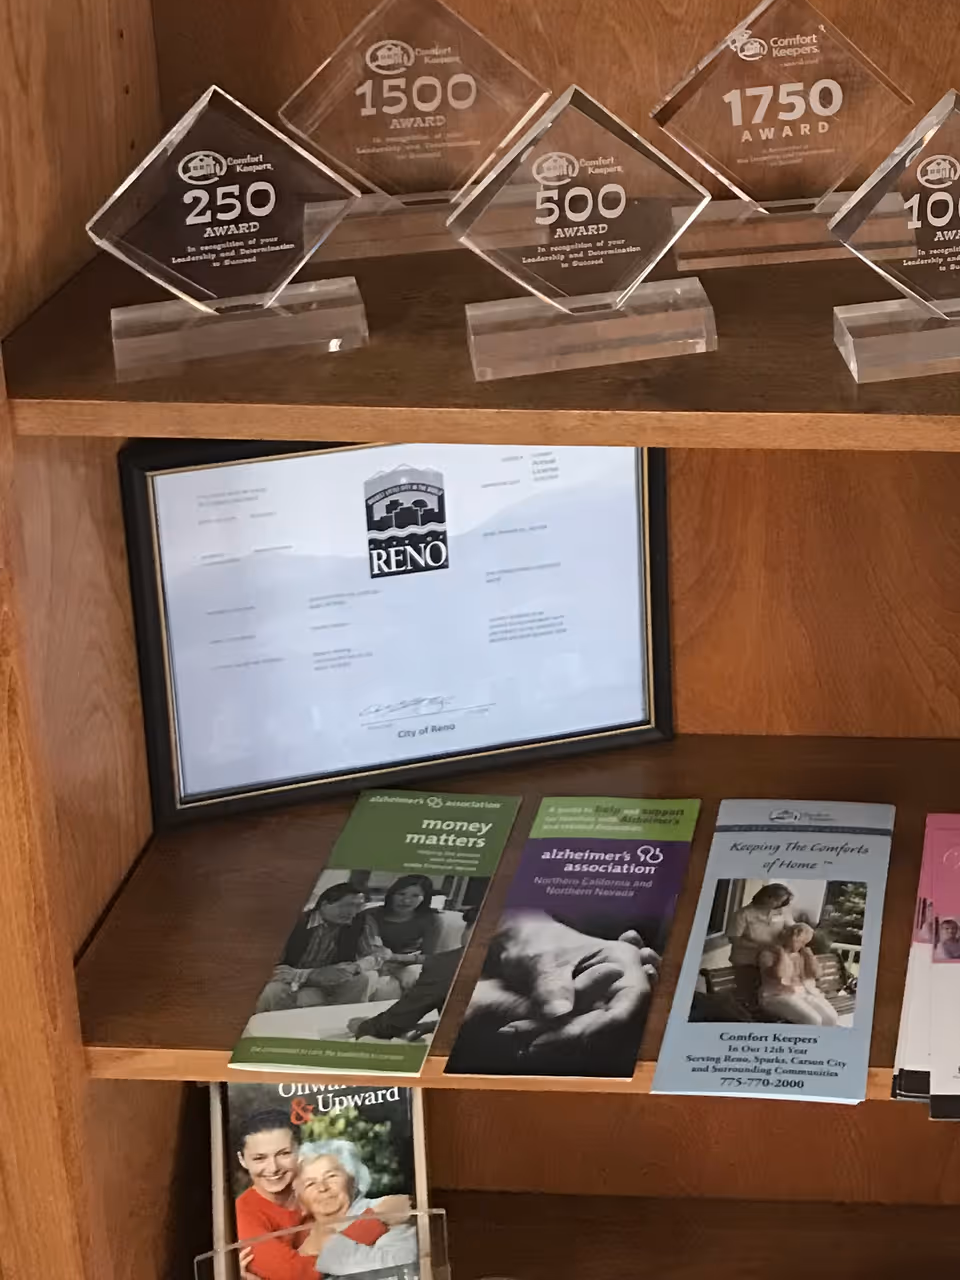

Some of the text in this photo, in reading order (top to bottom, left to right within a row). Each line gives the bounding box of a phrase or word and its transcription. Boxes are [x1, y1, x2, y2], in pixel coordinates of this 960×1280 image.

[769, 33, 818, 48] Comfort
[355, 73, 477, 116] 1500
[722, 78, 843, 127] 1750
[390, 115, 446, 129] AWARD
[741, 121, 829, 143] AWARD
[227, 154, 263, 166] Comfort
[579, 156, 614, 167] Comfort
[183, 181, 276, 225] 250
[535, 183, 626, 225] 500
[203, 221, 260, 238] AWARD
[554, 223, 608, 239] AWARD
[903, 255, 944, 266] Leadership
[947, 254, 960, 262] and
[369, 540, 447, 575] RENO
[398, 723, 456, 738] City of Reno
[445, 800, 502, 809] association
[595, 804, 621, 815] help
[642, 808, 685, 817] support
[422, 819, 493, 836] money
[620, 815, 681, 826] Alzheimer's
[405, 833, 486, 848] matters
[541, 848, 631, 862] alzheimer's
[730, 841, 870, 857] Keeping The Comforts
[564, 862, 657, 875] association
[762, 858, 818, 873] of Home
[534, 876, 653, 888] Northern California and
[546, 886, 635, 897] Northern Nevada
[719, 1032, 818, 1045] Comfort Keepers
[728, 1044, 808, 1055] In Our 12th Year
[686, 1054, 847, 1069] Serving Reno, Sparks, Carson City
[691, 1065, 839, 1077] and Surrounding Communities
[720, 1077, 805, 1089] 775-770-2000
[290, 1086, 401, 1125] & Upward
